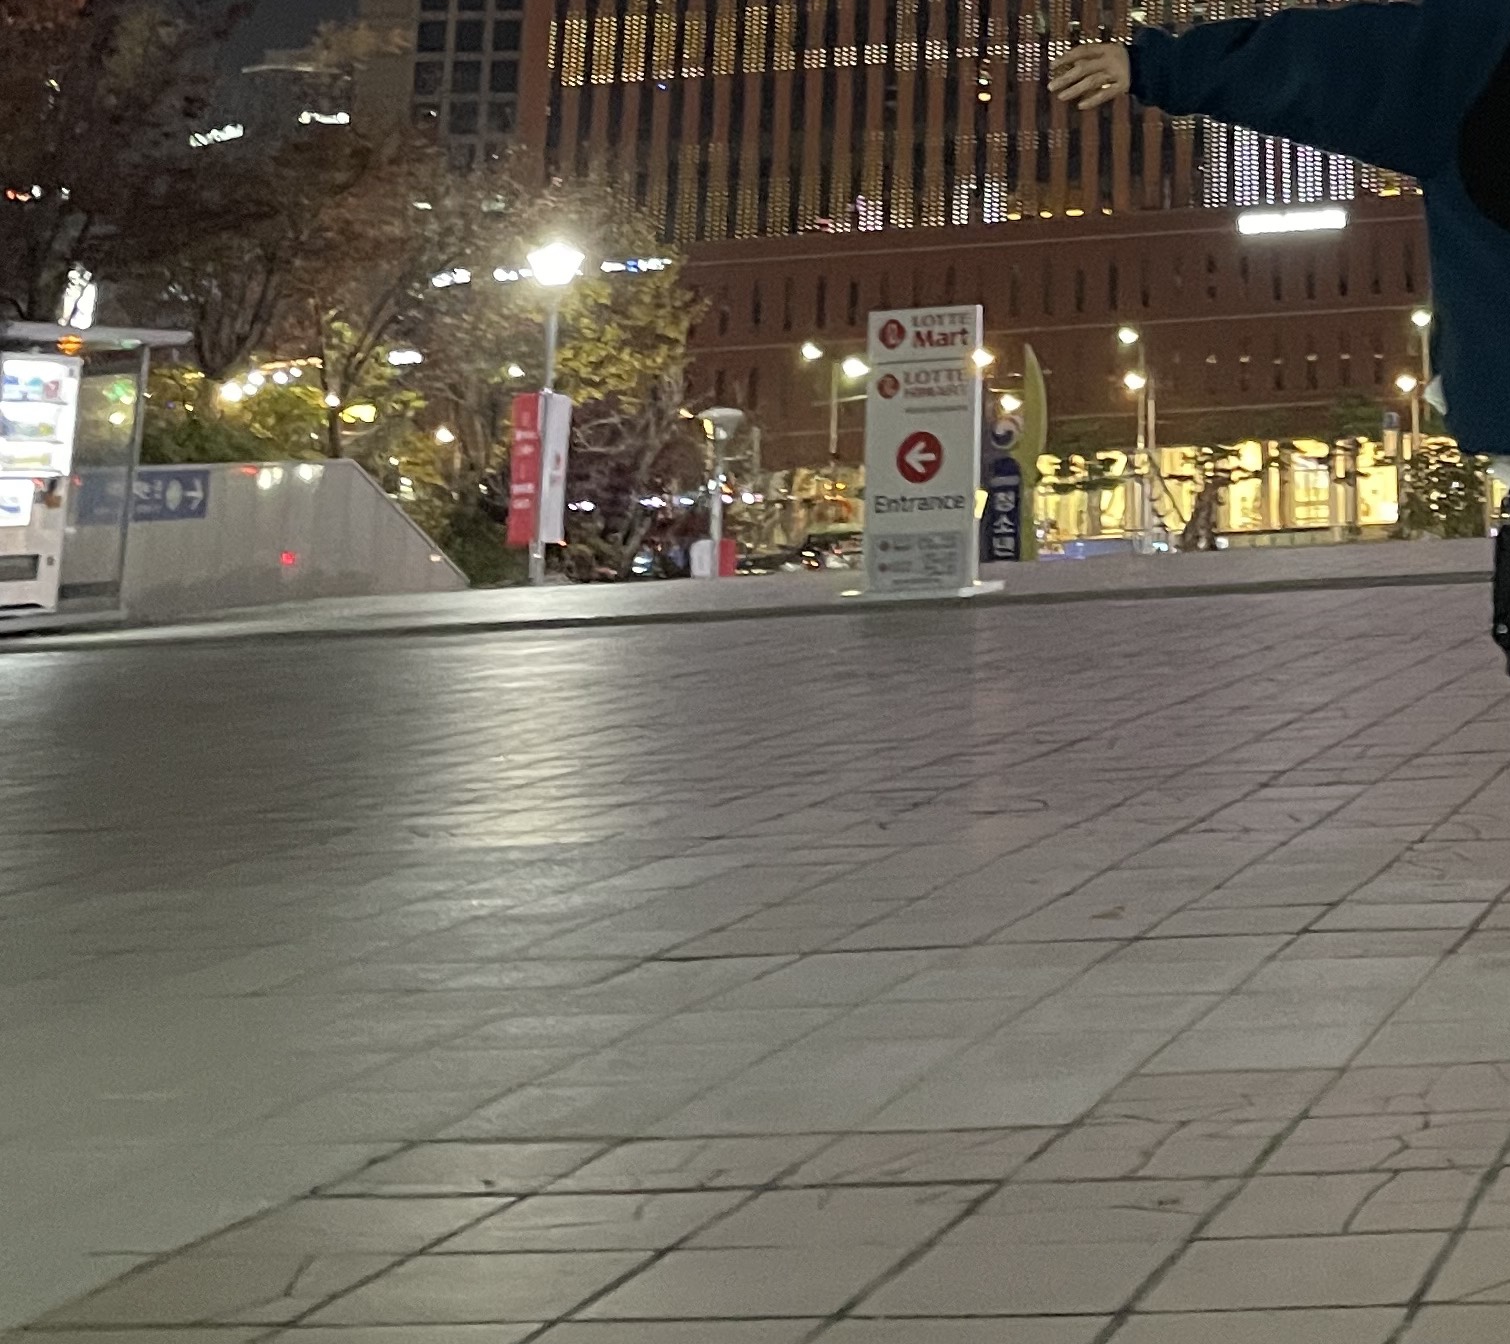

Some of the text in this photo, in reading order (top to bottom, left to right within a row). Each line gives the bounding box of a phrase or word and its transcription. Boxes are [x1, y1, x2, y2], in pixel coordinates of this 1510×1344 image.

[911, 312, 971, 328] LOTTE
[912, 328, 969, 348] Mart
[903, 369, 968, 385] LOTTE
[875, 495, 966, 514] Entrance
